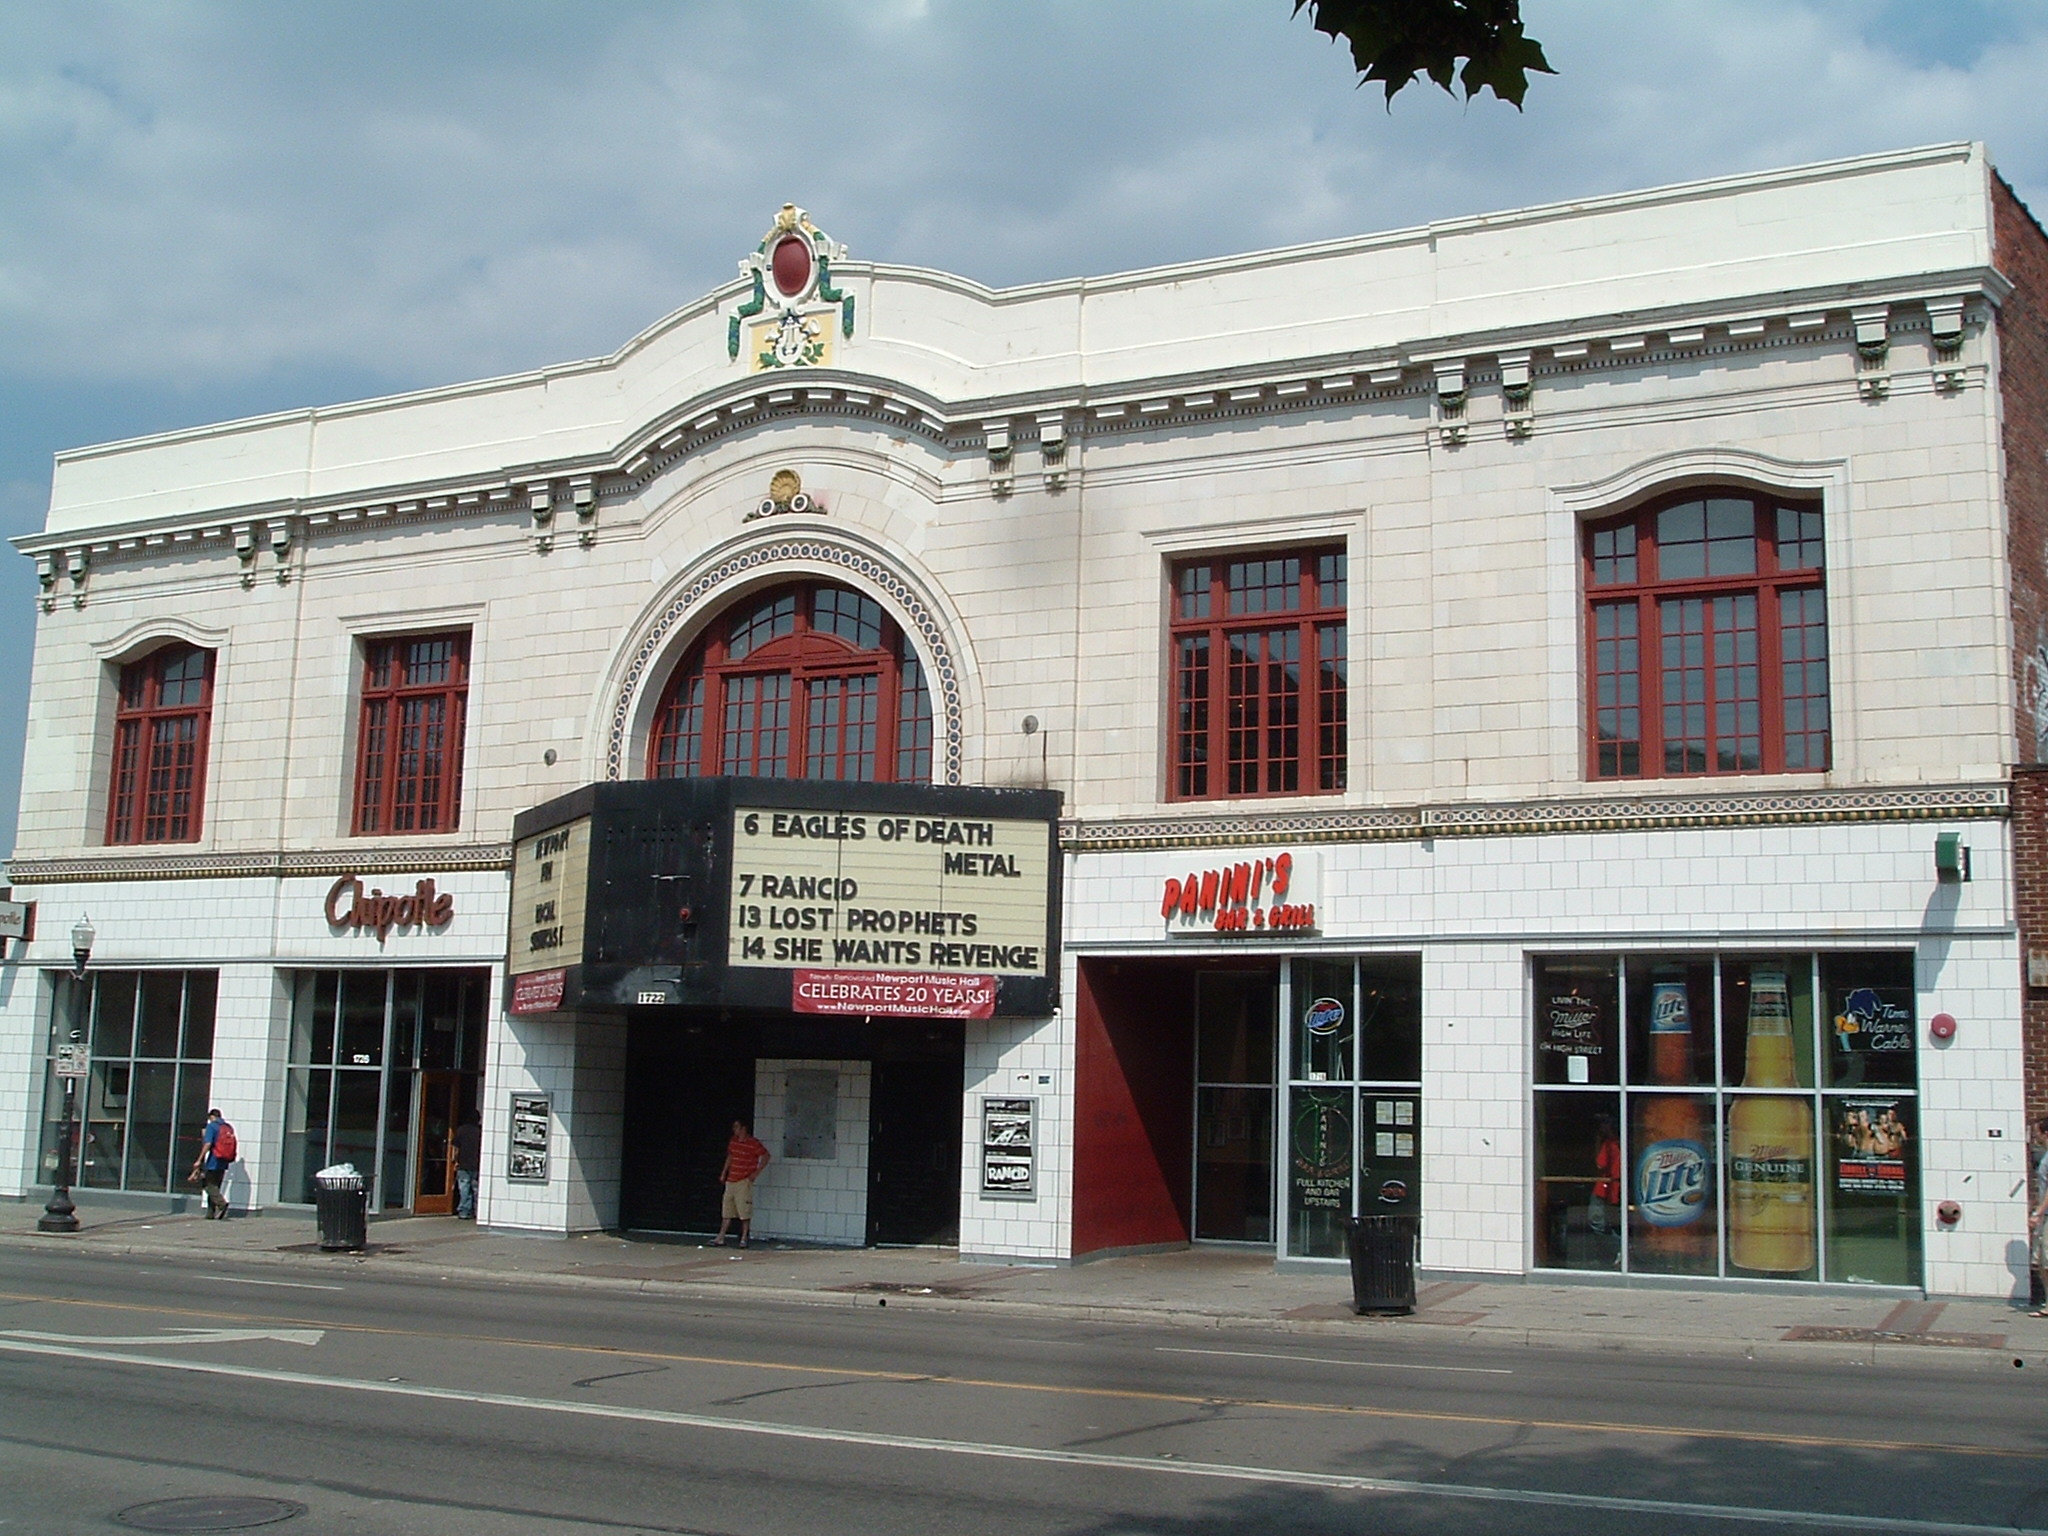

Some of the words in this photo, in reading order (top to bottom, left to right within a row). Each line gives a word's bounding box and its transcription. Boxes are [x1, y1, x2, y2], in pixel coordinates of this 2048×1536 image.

[744, 813, 759, 836] 6
[772, 813, 866, 840] EAGLES
[878, 819, 910, 841] OF
[915, 820, 994, 846] DEATH
[944, 852, 1021, 878] METAL
[739, 874, 755, 897] 7
[761, 875, 858, 901] RANCID
[1161, 852, 1293, 920] PANINI'S
[325, 873, 455, 942] Chipotle
[1214, 907, 1248, 930] BAR
[1253, 908, 1265, 926] &
[1269, 904, 1315, 928] GRILL
[739, 904, 761, 928] 13
[770, 906, 833, 931] LOST
[847, 908, 977, 936] PROPHETS
[742, 936, 766, 960] 14
[774, 937, 822, 962] SHE
[832, 938, 921, 964] WANTS
[930, 942, 1038, 969] REVENGE
[876, 974, 923, 985] Newport
[925, 976, 956, 986] Music
[959, 976, 980, 986] Hall
[640, 993, 664, 1003] 1722
[799, 983, 901, 1001] CELEBRATES
[905, 987, 927, 1002] 20
[932, 988, 990, 1004] YEARS!
[817, 1002, 971, 1015] www.NewportMusicHall.com
[1550, 1010, 1597, 1027] Miller
[1882, 1003, 1910, 1019] Time
[1861, 1018, 1912, 1034] Warner
[1871, 1034, 1911, 1050] Cable
[1735, 1160, 1804, 1174] GENUINE
[1643, 1160, 1704, 1205] Lite
